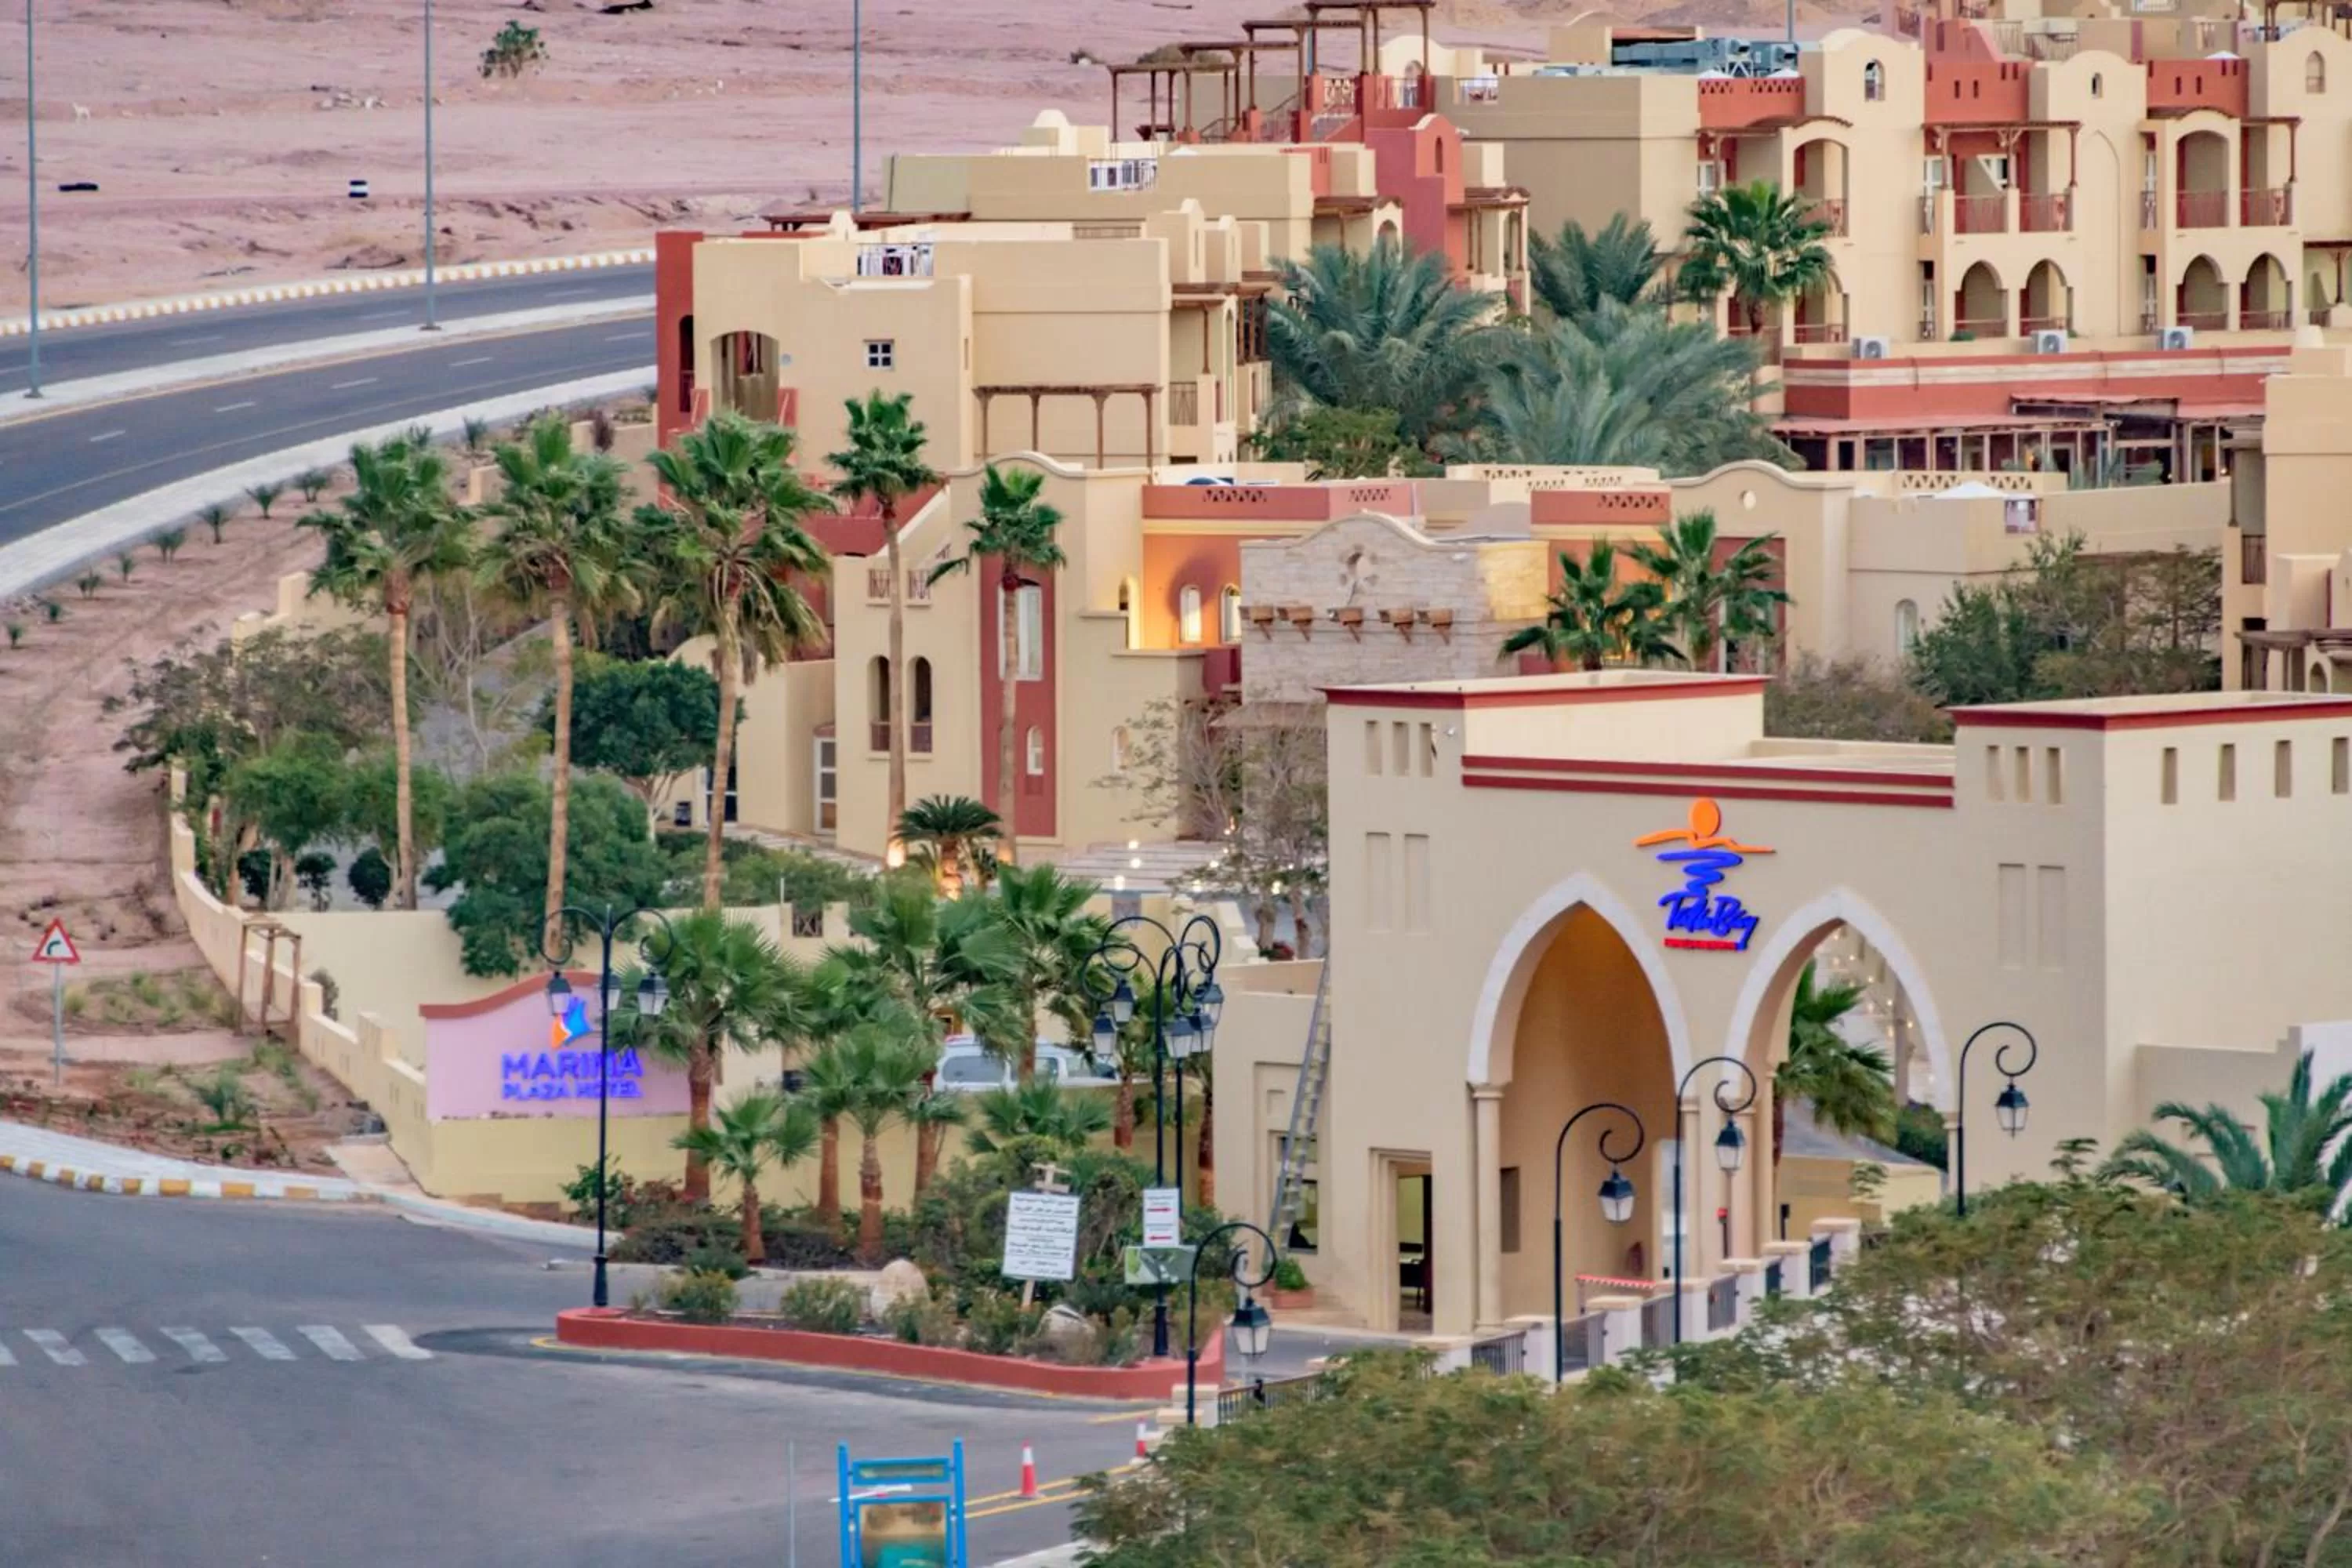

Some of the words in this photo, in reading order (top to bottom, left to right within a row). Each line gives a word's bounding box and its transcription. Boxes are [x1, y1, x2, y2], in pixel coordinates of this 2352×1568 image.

[1710, 895, 1760, 951] Bay
[501, 1048, 644, 1080] MARINA
[501, 1081, 570, 1100] PLAZA
[575, 1079, 642, 1098] HOTEL
